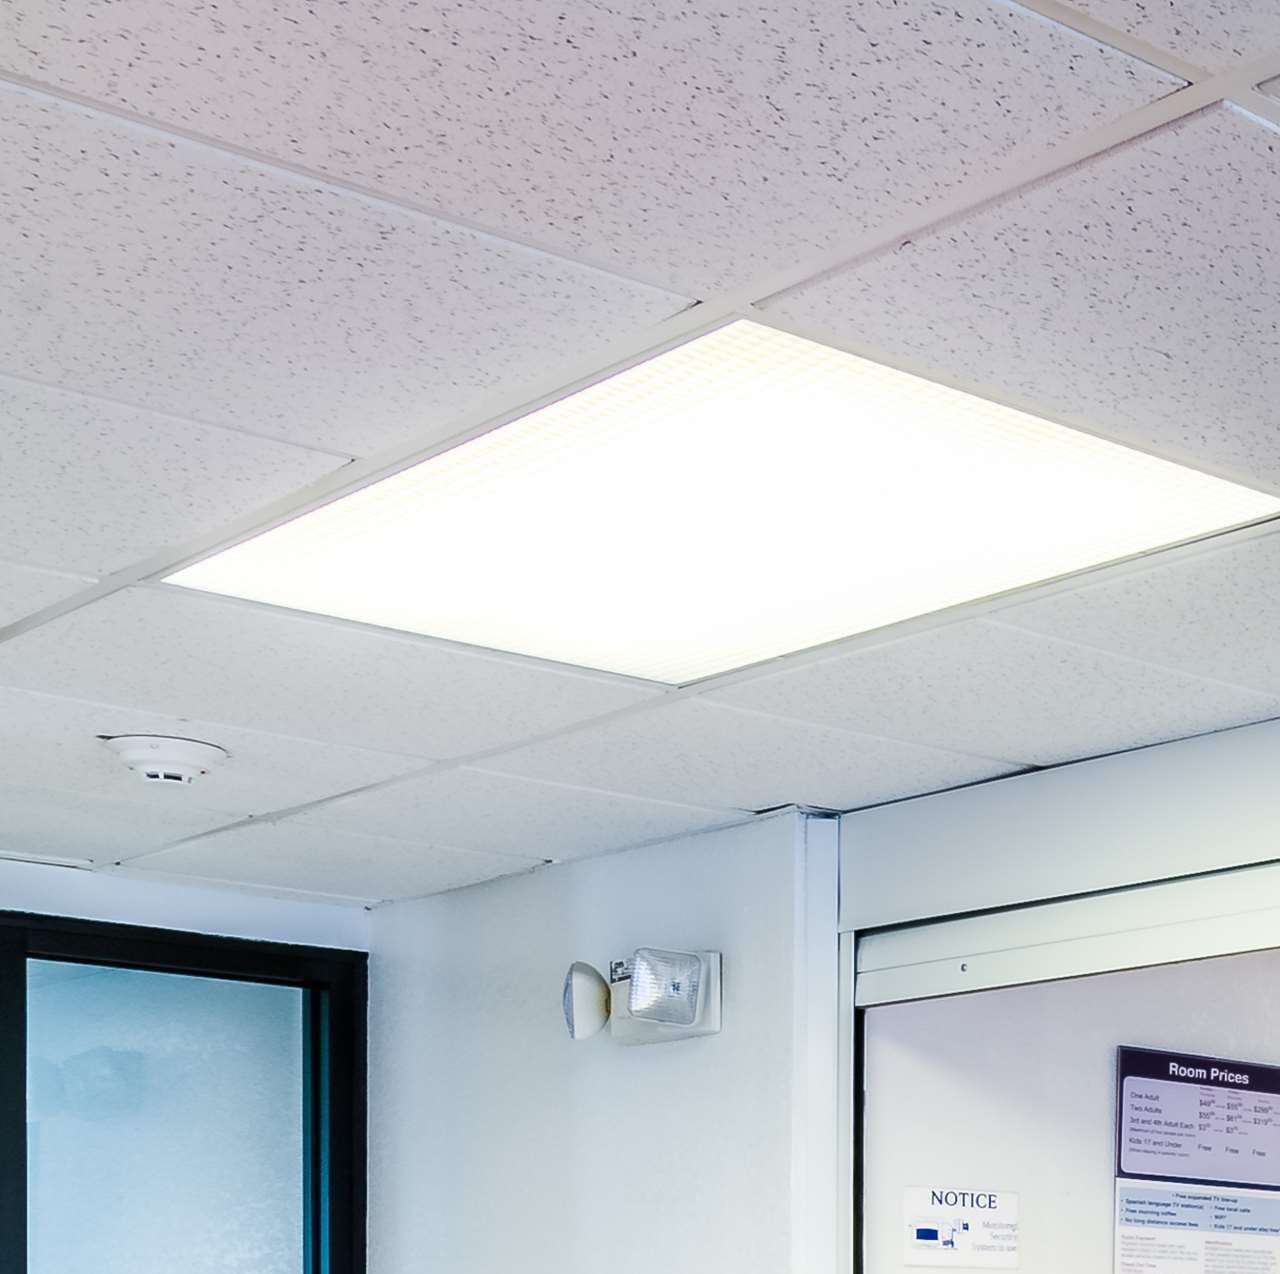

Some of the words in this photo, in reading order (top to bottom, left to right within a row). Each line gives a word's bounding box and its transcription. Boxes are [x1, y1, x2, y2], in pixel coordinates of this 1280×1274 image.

[1169, 1062, 1207, 1079] Room
[1210, 1068, 1249, 1084] Prices
[1130, 1091, 1144, 1100] One
[1144, 1093, 1160, 1102] Adult
[1130, 1103, 1144, 1112] Two
[1144, 1105, 1162, 1114] Adults
[1164, 1120, 1178, 1128] Adult
[1165, 1141, 1182, 1149] Under
[931, 1190, 998, 1209] NOTICE
